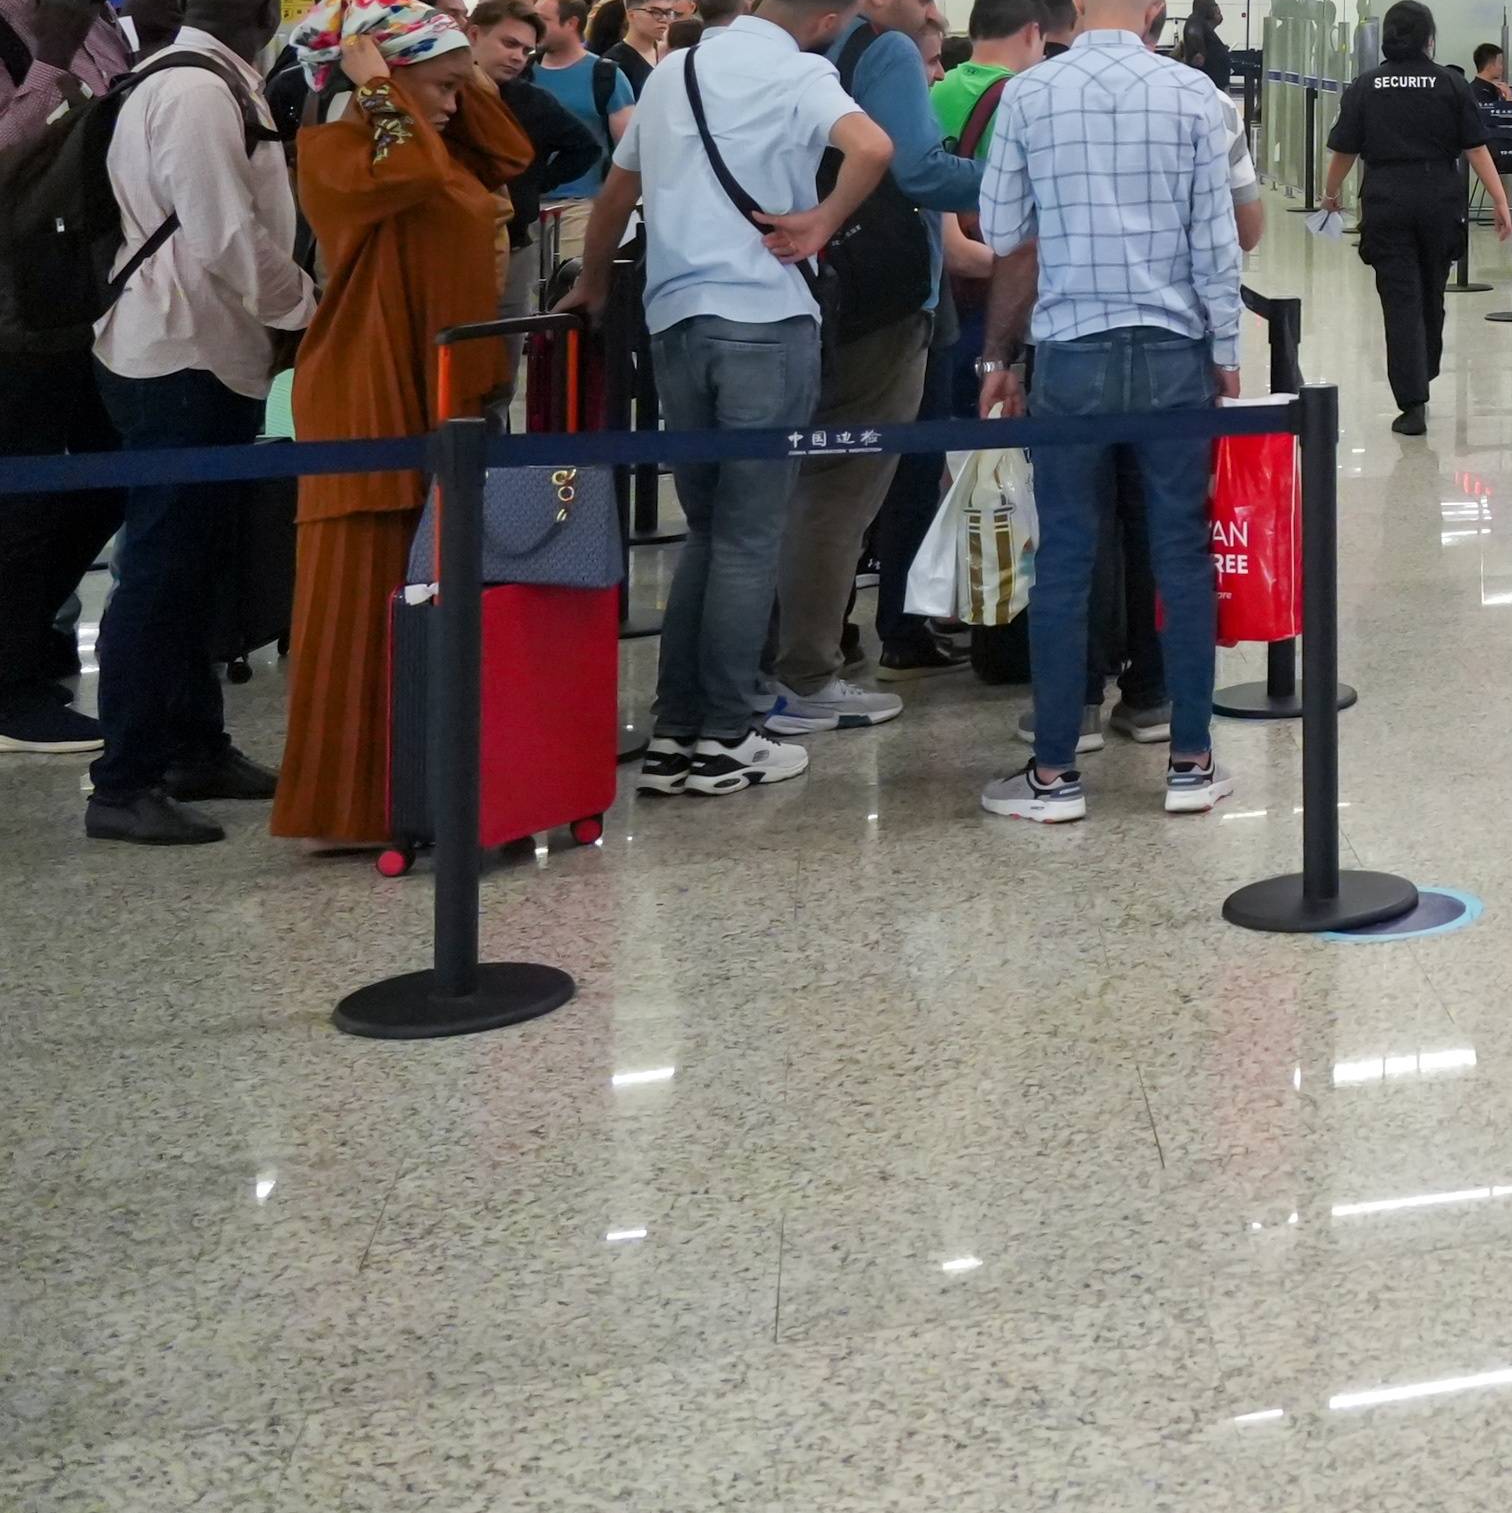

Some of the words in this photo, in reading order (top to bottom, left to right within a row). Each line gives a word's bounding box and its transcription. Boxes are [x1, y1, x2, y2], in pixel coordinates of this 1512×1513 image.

[1373, 76, 1437, 88] SECURITY
[788, 428, 882, 449] 中国边检
[1209, 519, 1248, 548] AN
